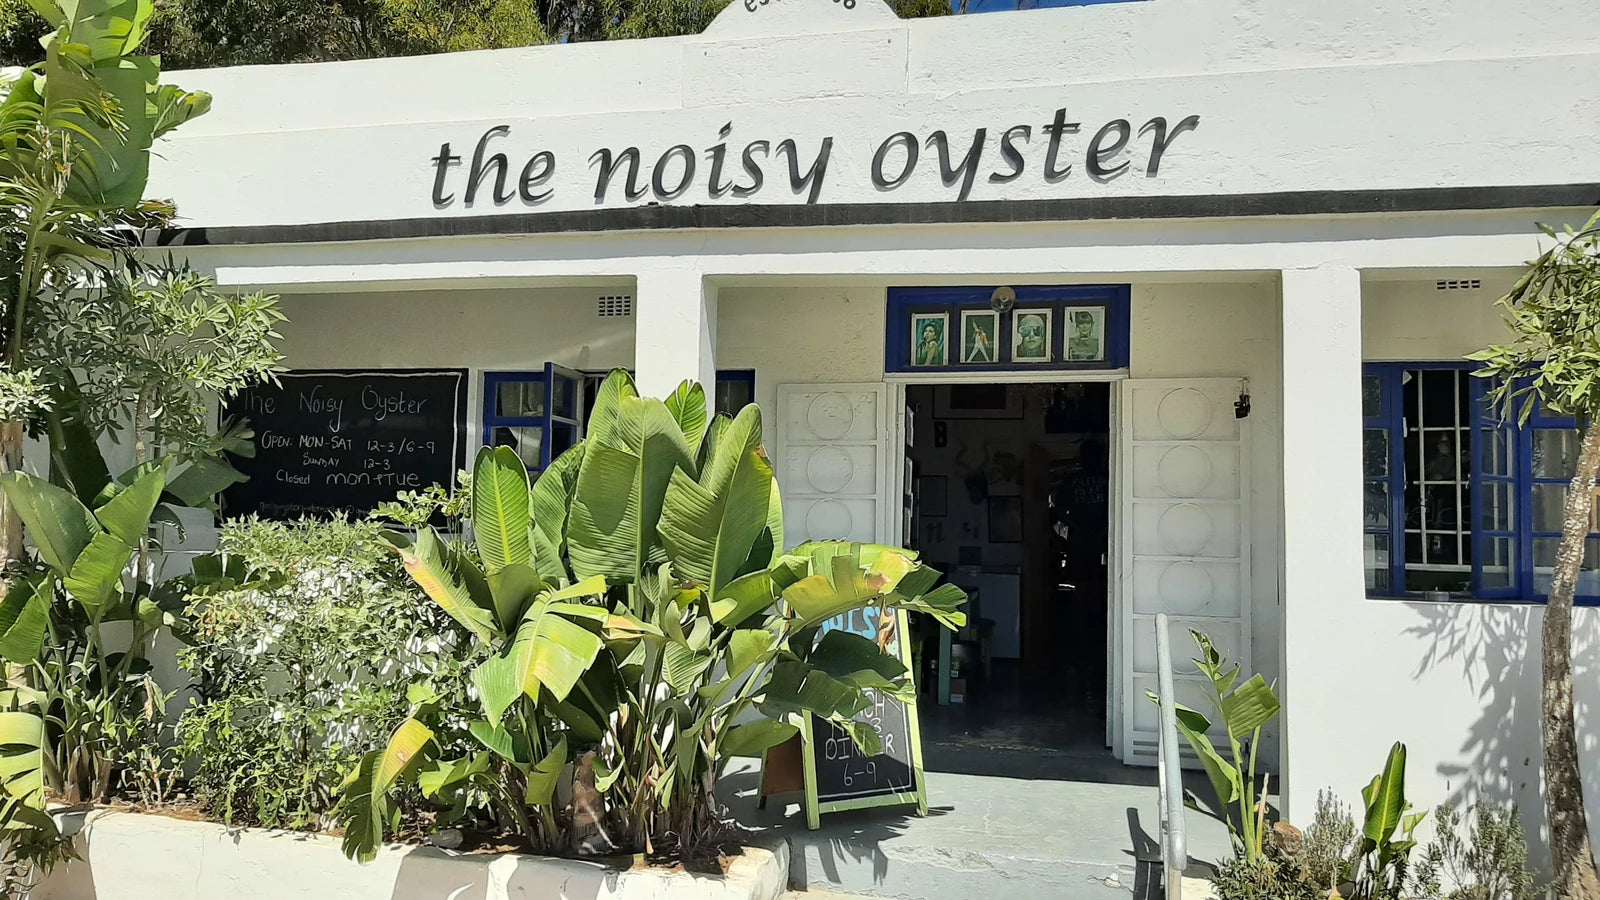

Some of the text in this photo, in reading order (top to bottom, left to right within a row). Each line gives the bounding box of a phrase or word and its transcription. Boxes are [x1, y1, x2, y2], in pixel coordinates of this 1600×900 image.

[431, 108, 1200, 209] the noisy oyster
[244, 384, 428, 433] The Noisy Oyster
[299, 434, 352, 450] MON-SAT
[363, 458, 391, 470] 12-3
[276, 469, 311, 485] Closed
[826, 733, 895, 760] DINR
[843, 762, 877, 787] 6-9
